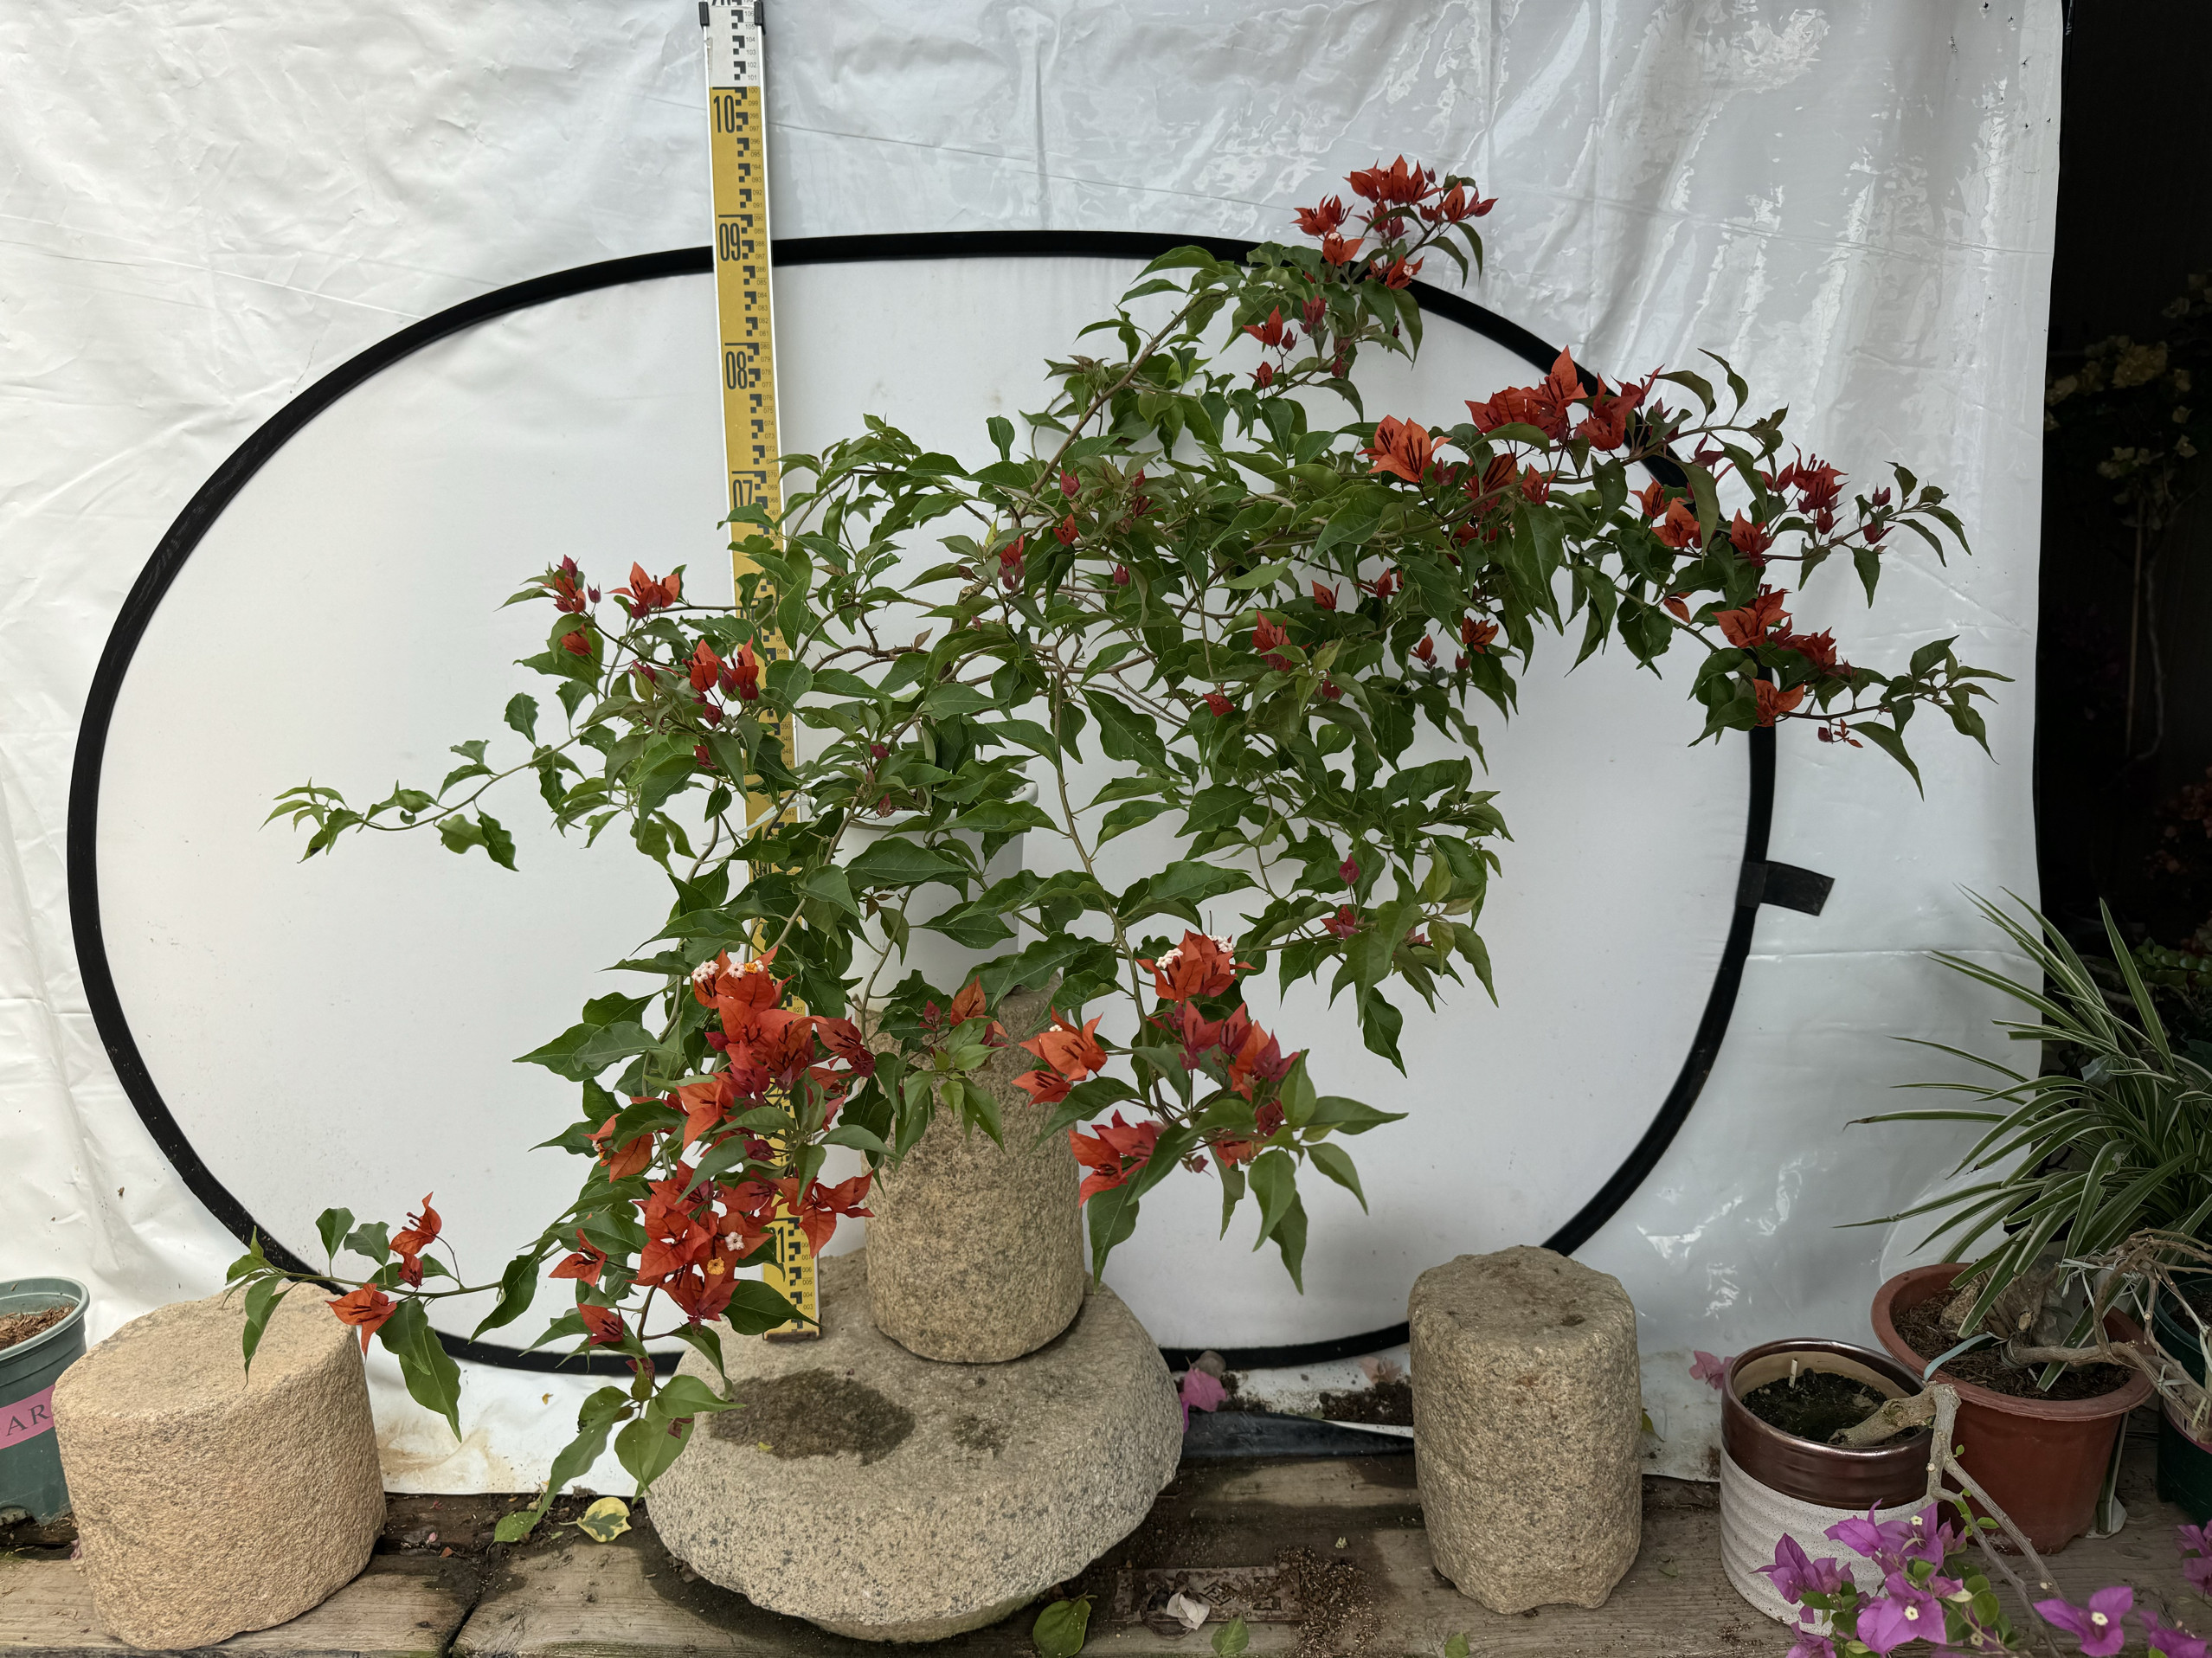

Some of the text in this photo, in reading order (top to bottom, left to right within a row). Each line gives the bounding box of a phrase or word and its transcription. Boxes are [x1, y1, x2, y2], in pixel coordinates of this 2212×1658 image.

[713, 94, 735, 133] 10
[719, 222, 741, 261] 09
[726, 351, 748, 389] 08
[732, 479, 753, 508] 07
[769, 1226, 784, 1263] 1
